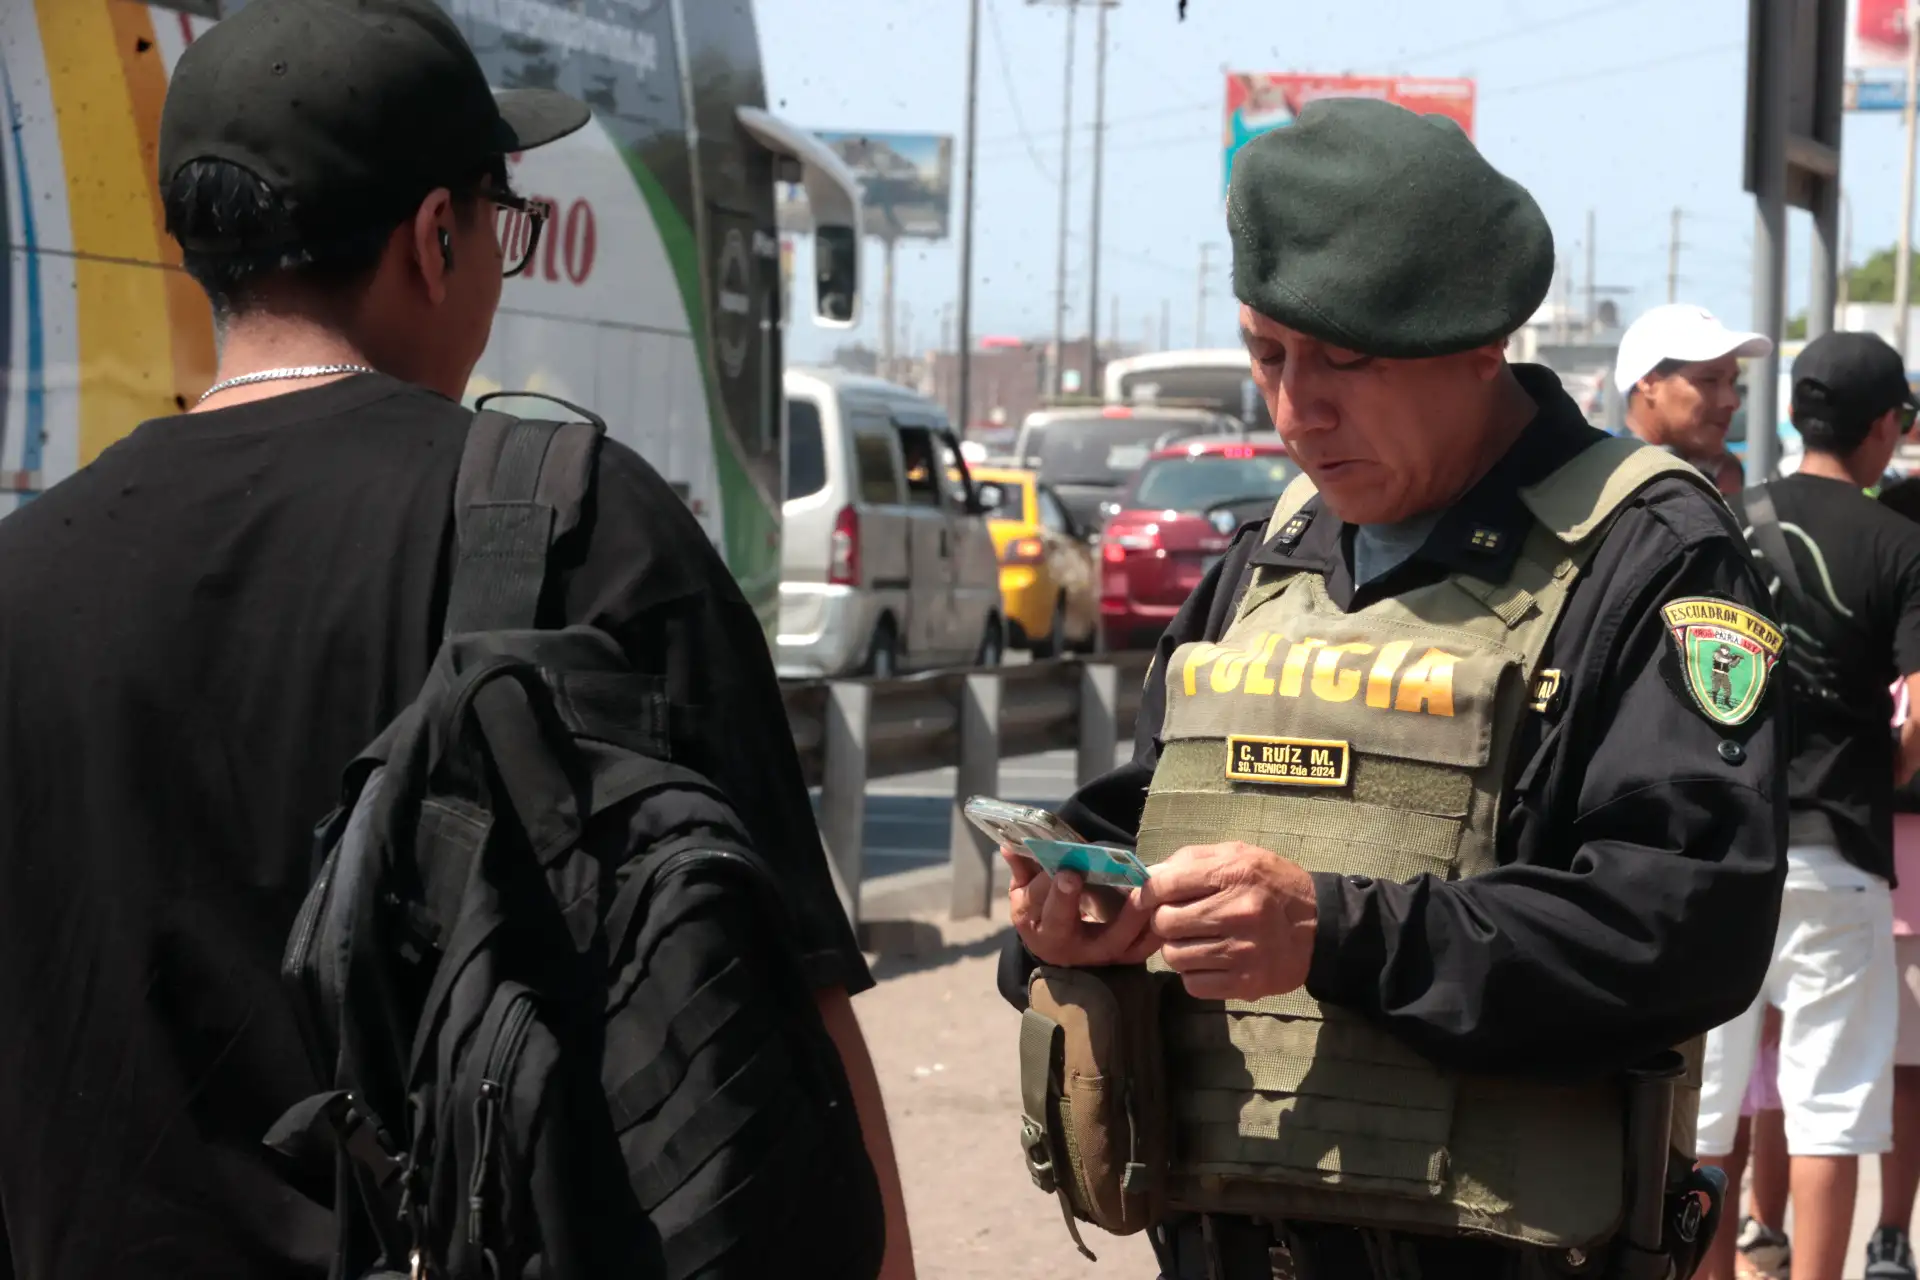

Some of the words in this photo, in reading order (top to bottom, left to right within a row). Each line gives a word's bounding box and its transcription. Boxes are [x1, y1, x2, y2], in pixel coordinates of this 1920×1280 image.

[1714, 630, 1740, 645] PATRIA
[1745, 614, 1780, 650] VERDE
[1183, 632, 1463, 717] POLICIA
[1240, 744, 1255, 762] C.
[1262, 744, 1302, 764] RUÍZ
[1310, 748, 1334, 767] M.
[1237, 760, 1252, 773] SO.
[1253, 762, 1288, 775] TECNICO
[1290, 764, 1308, 776] 2da
[1310, 766, 1336, 778] 2024
